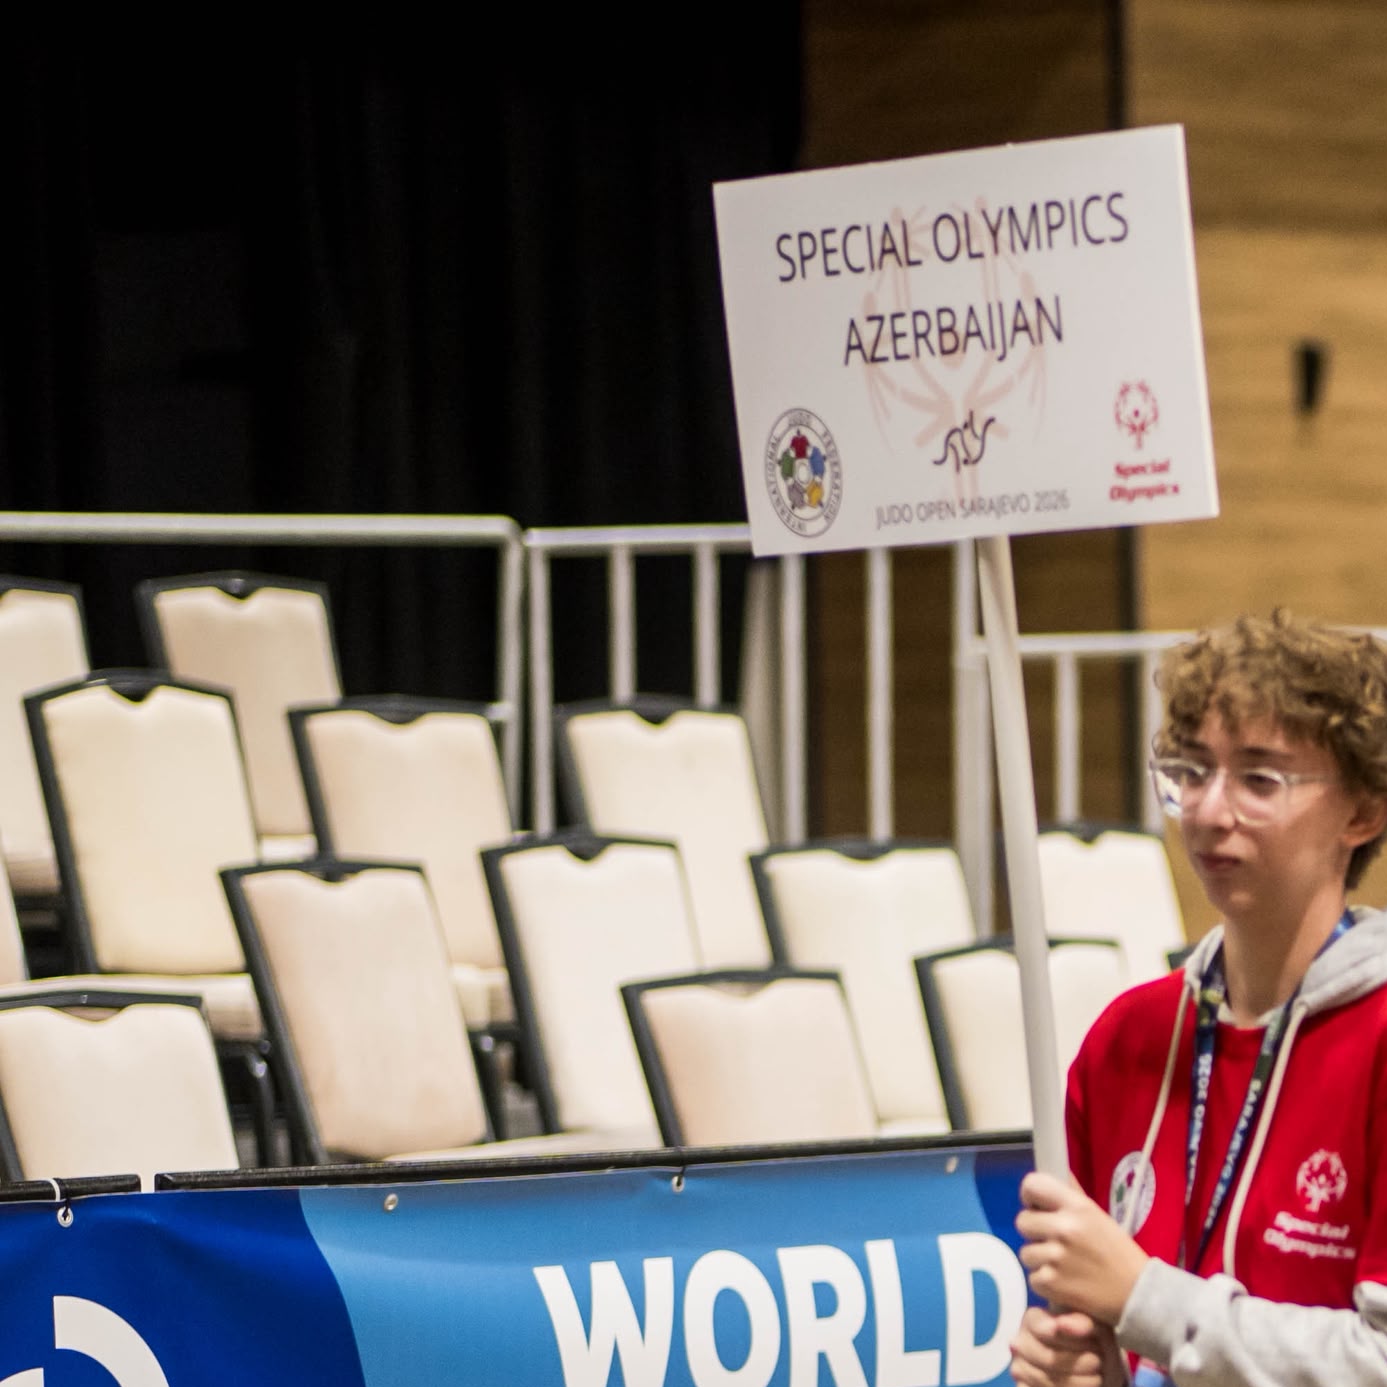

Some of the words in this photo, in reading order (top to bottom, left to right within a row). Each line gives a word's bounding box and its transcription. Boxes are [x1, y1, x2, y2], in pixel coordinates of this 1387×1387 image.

[777, 218, 922, 282] SPECIAL
[932, 192, 1128, 263] OLYMPICS
[844, 295, 1063, 366] AZERBAIJAN
[1114, 458, 1170, 481] Special
[875, 503, 913, 529] JUDO
[917, 501, 956, 522] OPEN
[958, 493, 1031, 519] SARAJEVO
[1034, 490, 1071, 512] 2026
[1108, 482, 1180, 504] Olympics
[1274, 1210, 1350, 1240] Special
